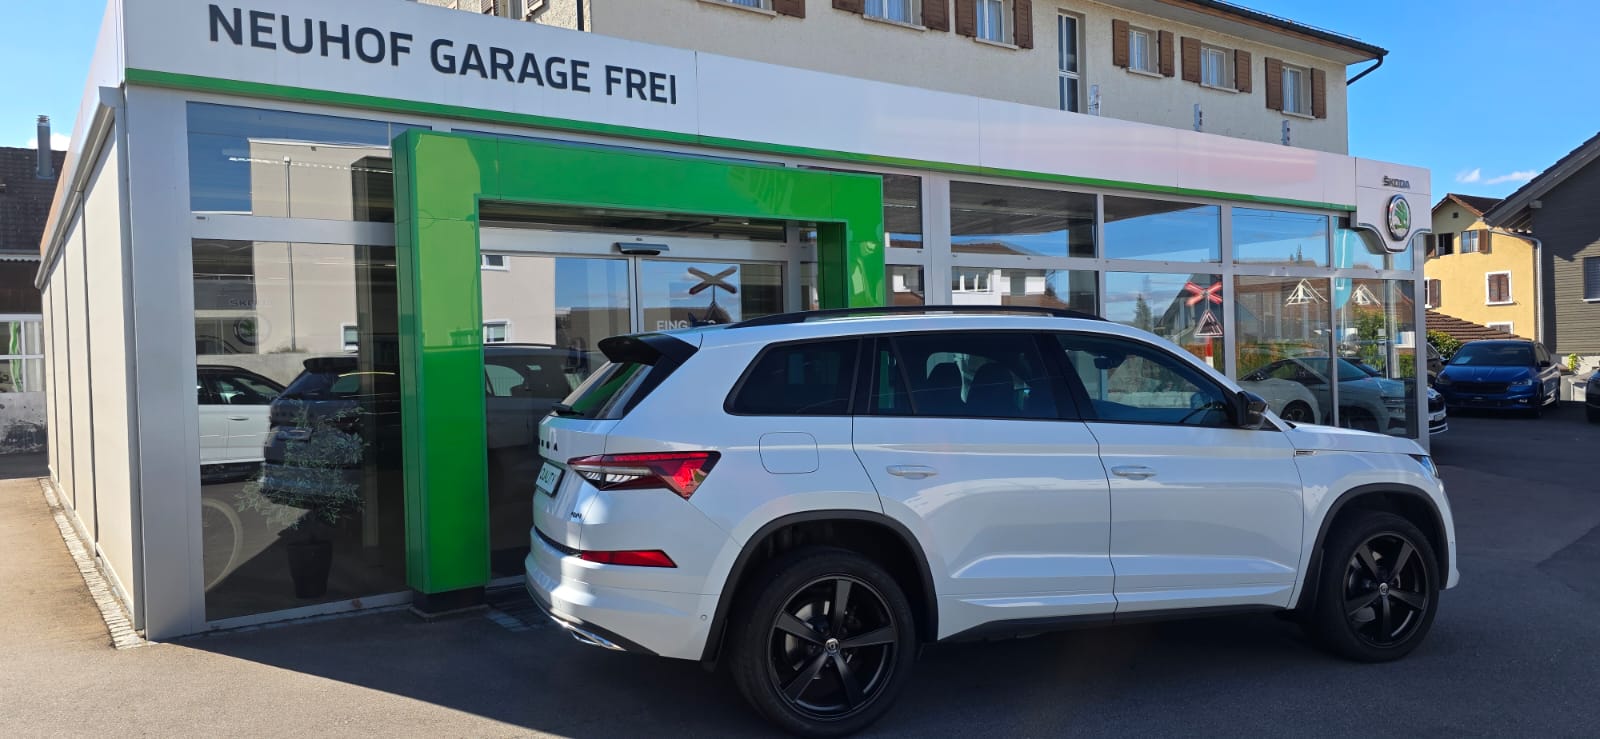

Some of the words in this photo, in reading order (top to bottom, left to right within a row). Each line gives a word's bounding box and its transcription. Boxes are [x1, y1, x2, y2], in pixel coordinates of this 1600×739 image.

[209, 4, 413, 66] NEUHOF
[430, 38, 591, 92] GARAGE
[605, 64, 677, 104] FREI
